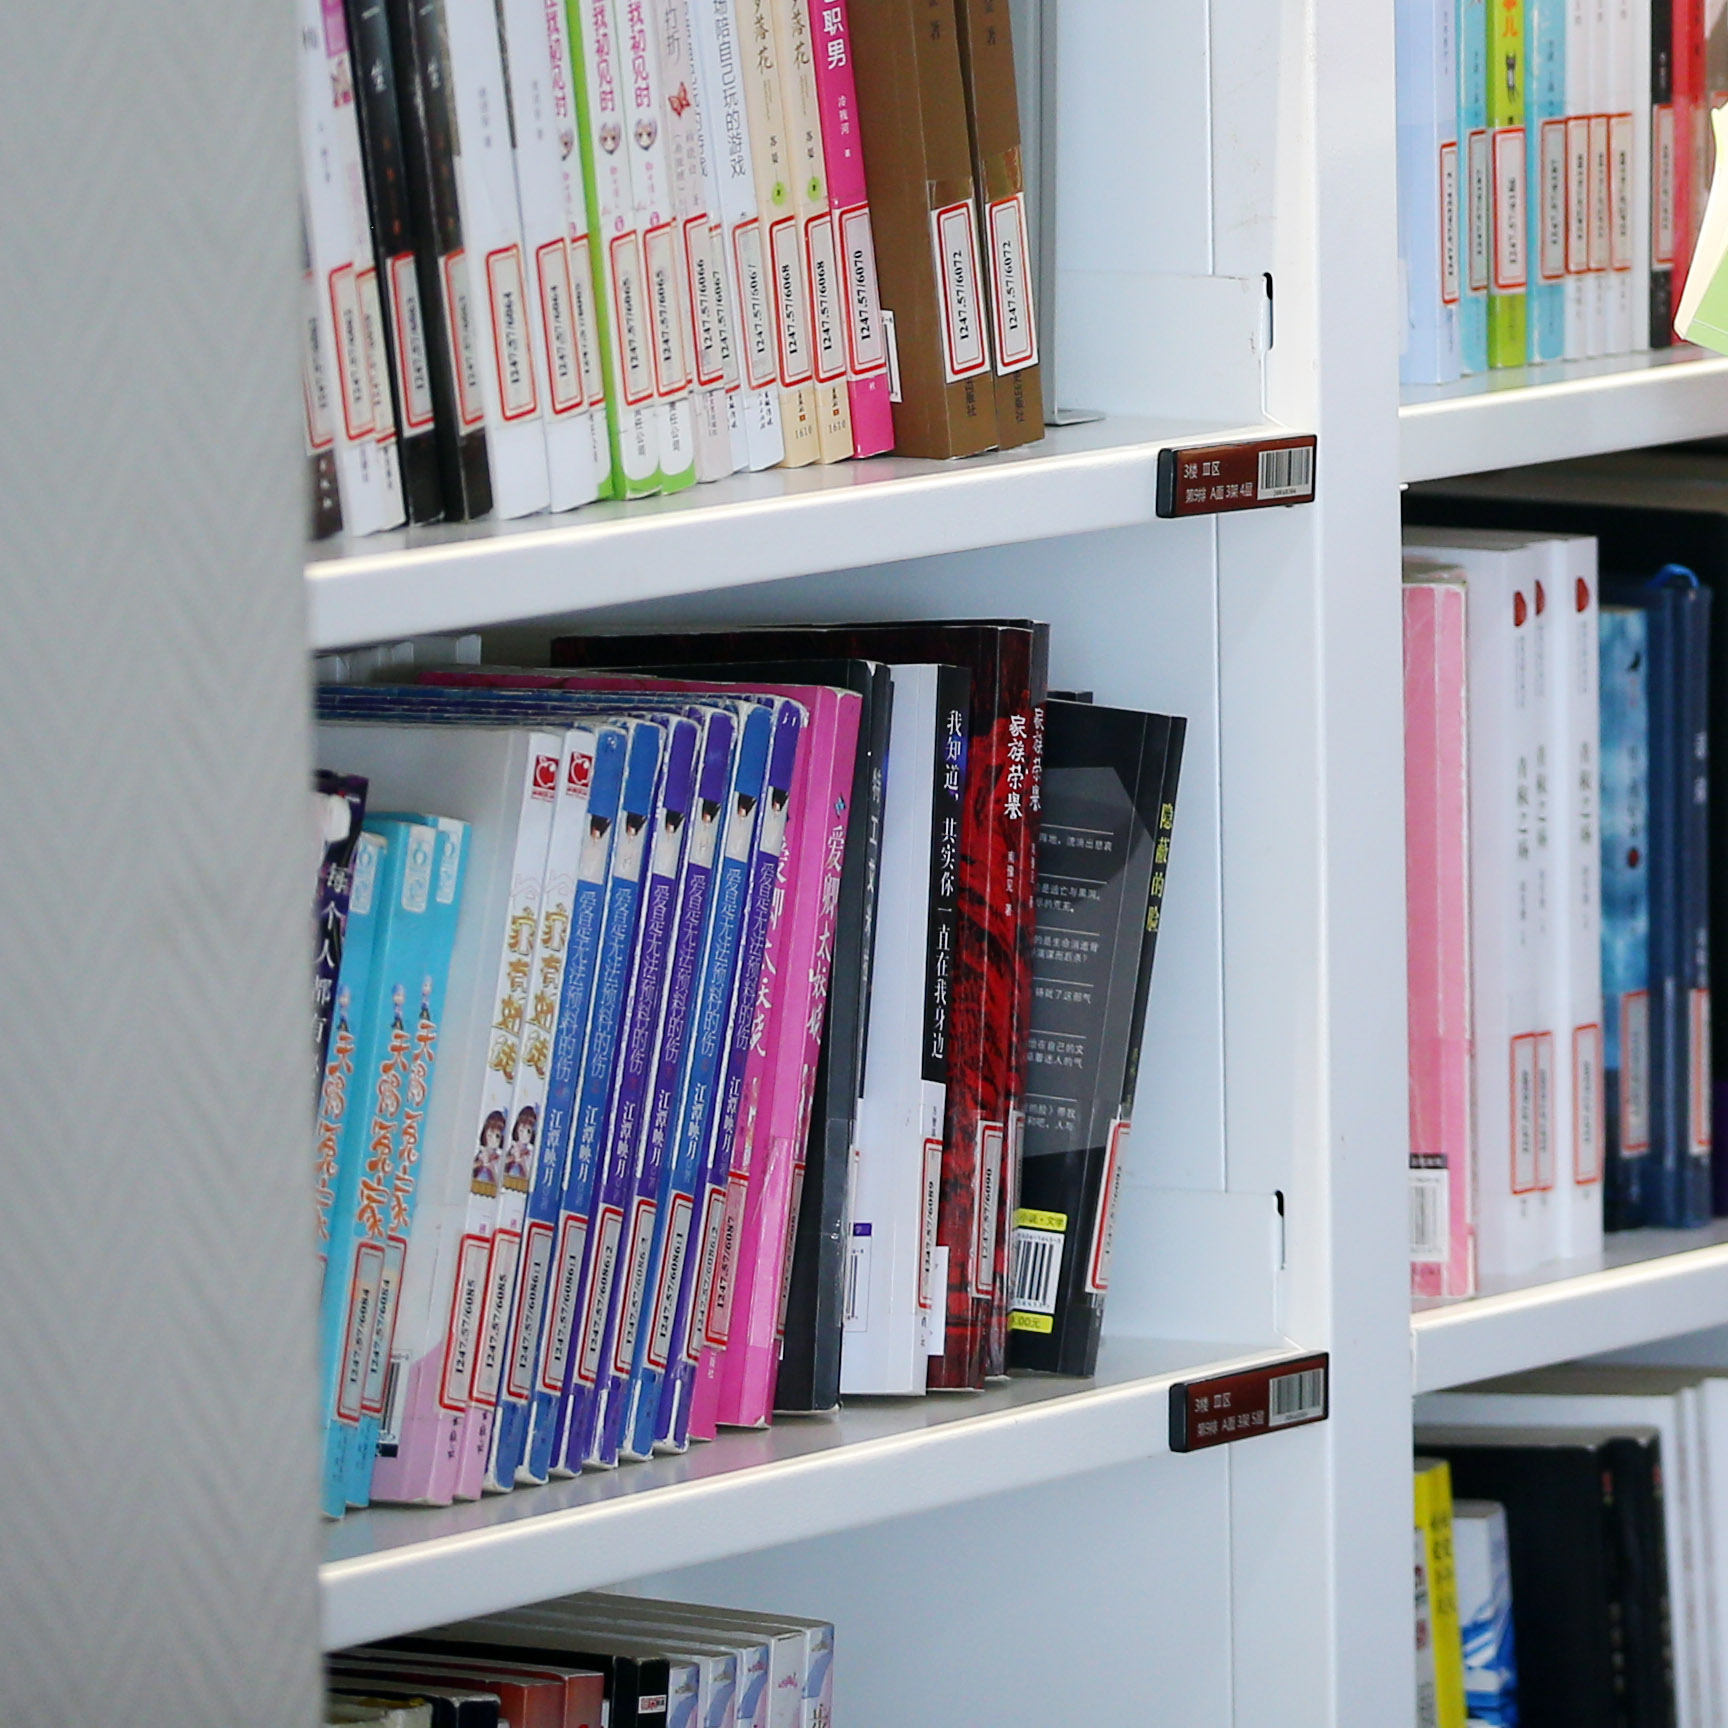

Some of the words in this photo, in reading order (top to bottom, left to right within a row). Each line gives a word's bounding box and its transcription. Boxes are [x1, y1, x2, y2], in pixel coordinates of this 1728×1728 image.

[780, 264, 799, 355] I247.57/6068
[816, 260, 834, 351] I247.57/6068
[853, 249, 871, 341] I247.57/6070
[955, 248, 974, 343] I247.57/6072
[1003, 240, 1019, 332] I247.57/6072
[1183, 463, 1198, 479] 3楼
[1209, 485, 1224, 501] A面
[1225, 483, 1239, 499] 3架
[1239, 482, 1253, 498] 4层
[1004, 713, 1028, 821] 家族荣誉
[931, 709, 964, 1060] 我知道，其实你一直在我身边
[1146, 803, 1173, 933] 隐蔽的脸
[591, 887, 633, 1080] 爱是无法预料的伤
[628, 883, 672, 1077] 爱是无法预料的伤
[665, 873, 708, 1065] 爱是无法预料的伤
[701, 867, 744, 1058] 爱是无法预料的伤
[802, 823, 845, 1049] 爱卿太妖娆
[554, 888, 598, 1084] 爱是无法预料的伤
[542, 1108, 563, 1187] 江潭映月
[577, 1103, 600, 1184] 江潭映月
[614, 1099, 636, 1180] 江潭映月
[650, 1088, 672, 1168] 江潭映月
[685, 1081, 708, 1161] 江潭映月
[720, 1075, 742, 1155] 江潭映月
[553, 1254, 577, 1362] I247.57/6086:1
[588, 1245, 614, 1353] I247.57/6086:2
[659, 1231, 684, 1339] I247.57/6086:1
[715, 1215, 736, 1309] I247.57/6087
[455, 1278, 476, 1374] I247.57/6085
[485, 1273, 508, 1369] I247.57/6085
[518, 1261, 542, 1369] I247.57/6086:1
